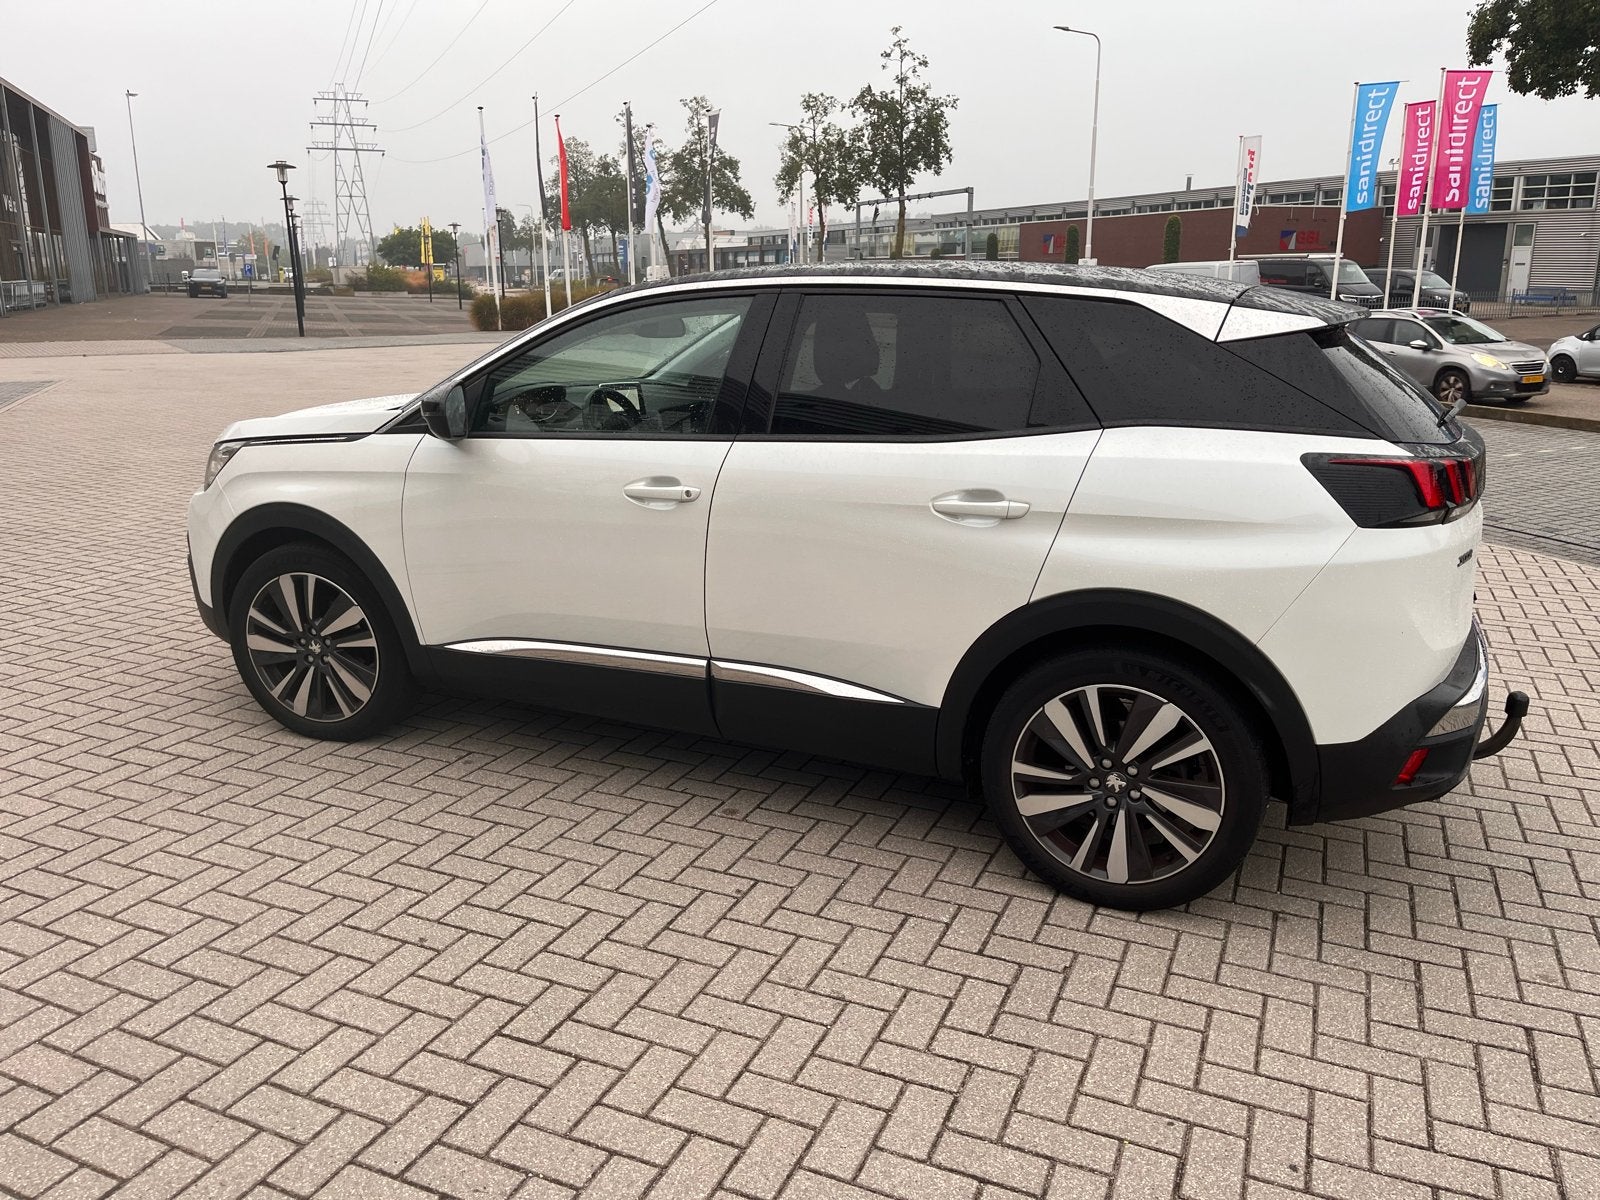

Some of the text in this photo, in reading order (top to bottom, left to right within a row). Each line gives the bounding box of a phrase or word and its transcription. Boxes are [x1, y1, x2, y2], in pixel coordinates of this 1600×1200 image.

[1356, 87, 1389, 204] sanidirect
[1407, 106, 1431, 210] sanidirect
[1475, 109, 1494, 209] sanidirect
